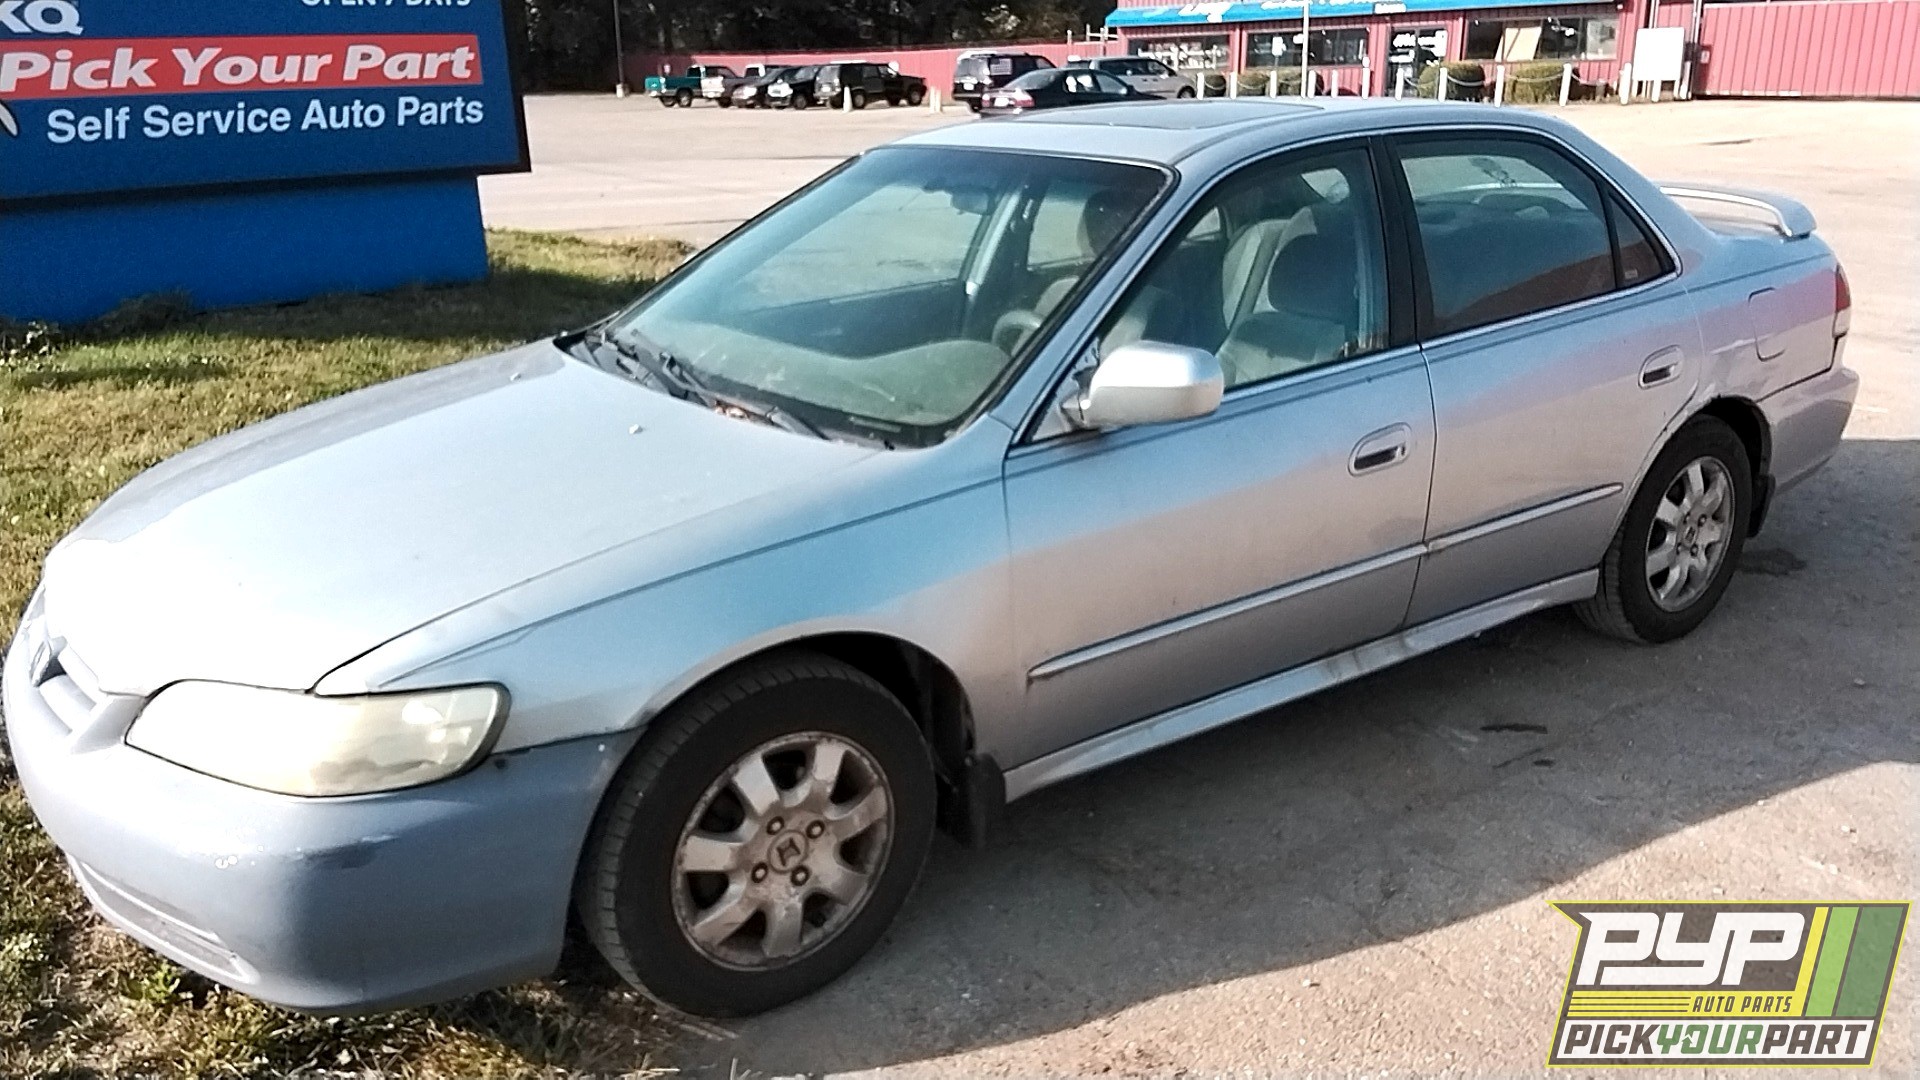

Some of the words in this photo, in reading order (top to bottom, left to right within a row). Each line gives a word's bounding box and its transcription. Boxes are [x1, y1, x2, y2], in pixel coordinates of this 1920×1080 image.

[0, 47, 159, 93] Pick
[171, 47, 333, 86] Your
[342, 44, 475, 81] Part
[47, 106, 130, 143] Self
[143, 101, 292, 138] Service
[301, 99, 386, 131] Auto
[397, 96, 484, 126] Parts
